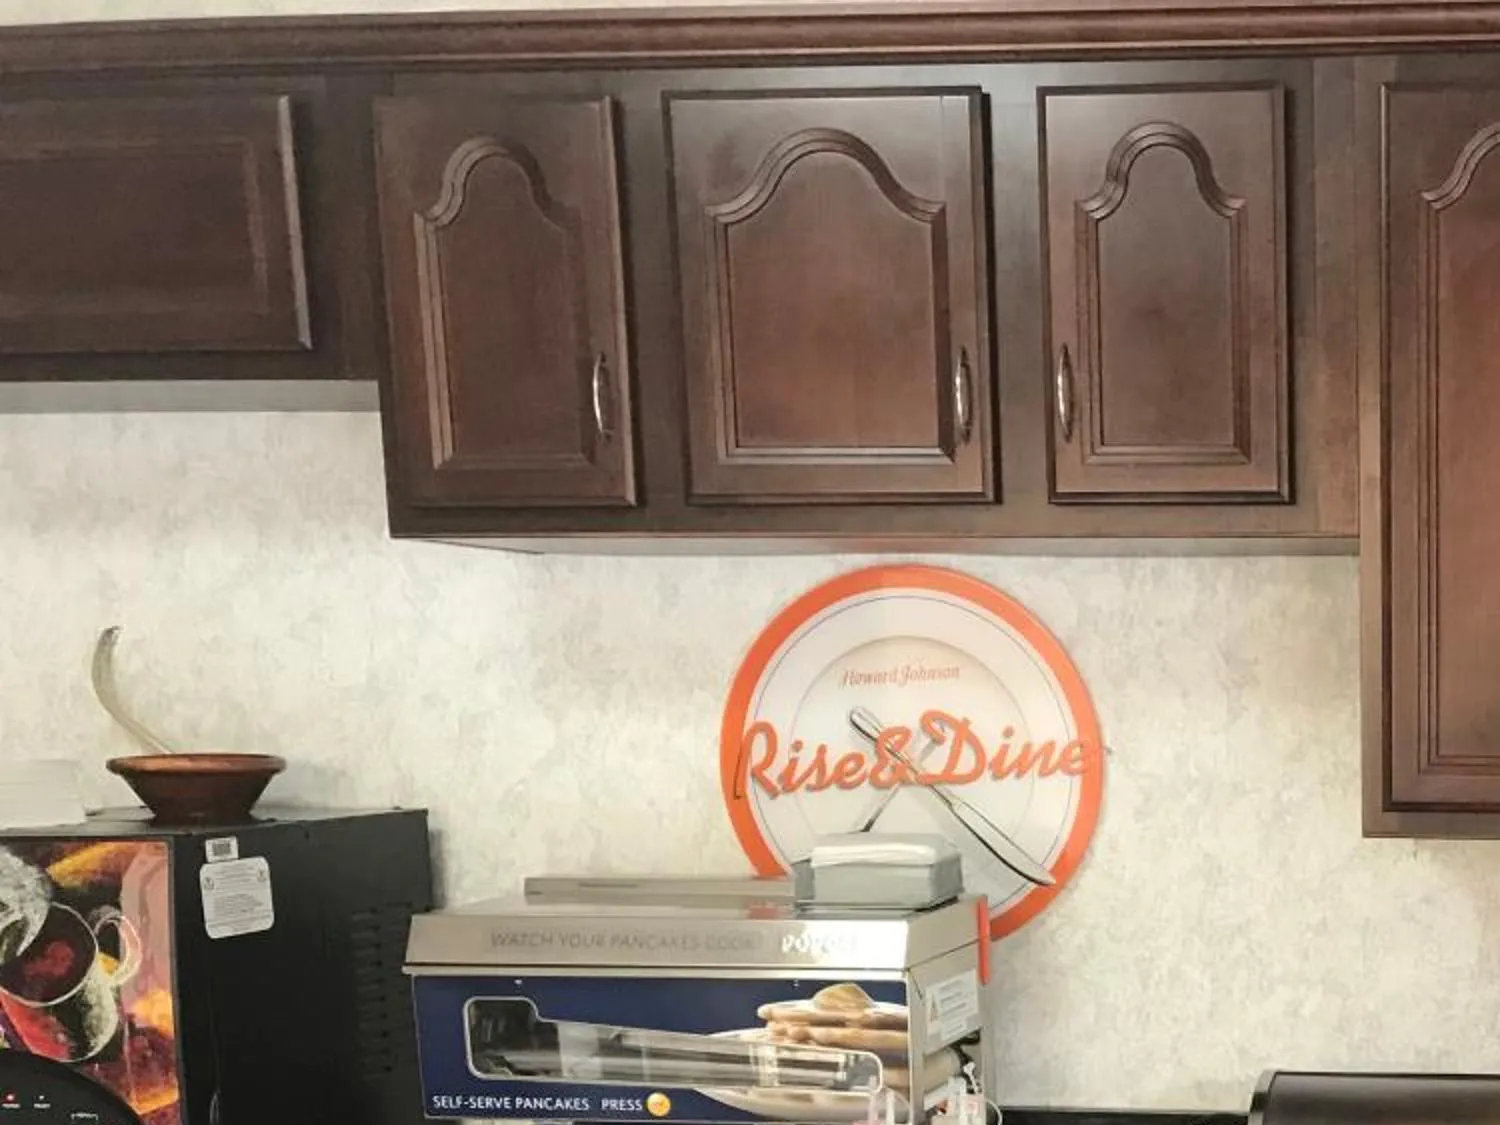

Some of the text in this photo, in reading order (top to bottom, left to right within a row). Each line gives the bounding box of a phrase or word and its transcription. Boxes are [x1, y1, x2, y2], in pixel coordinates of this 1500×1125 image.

[490, 931, 554, 948] WATCH
[432, 1095, 511, 1110] SELF-SERVE
[515, 1097, 590, 1111] PANCAKES
[601, 1098, 643, 1111] PRESS
